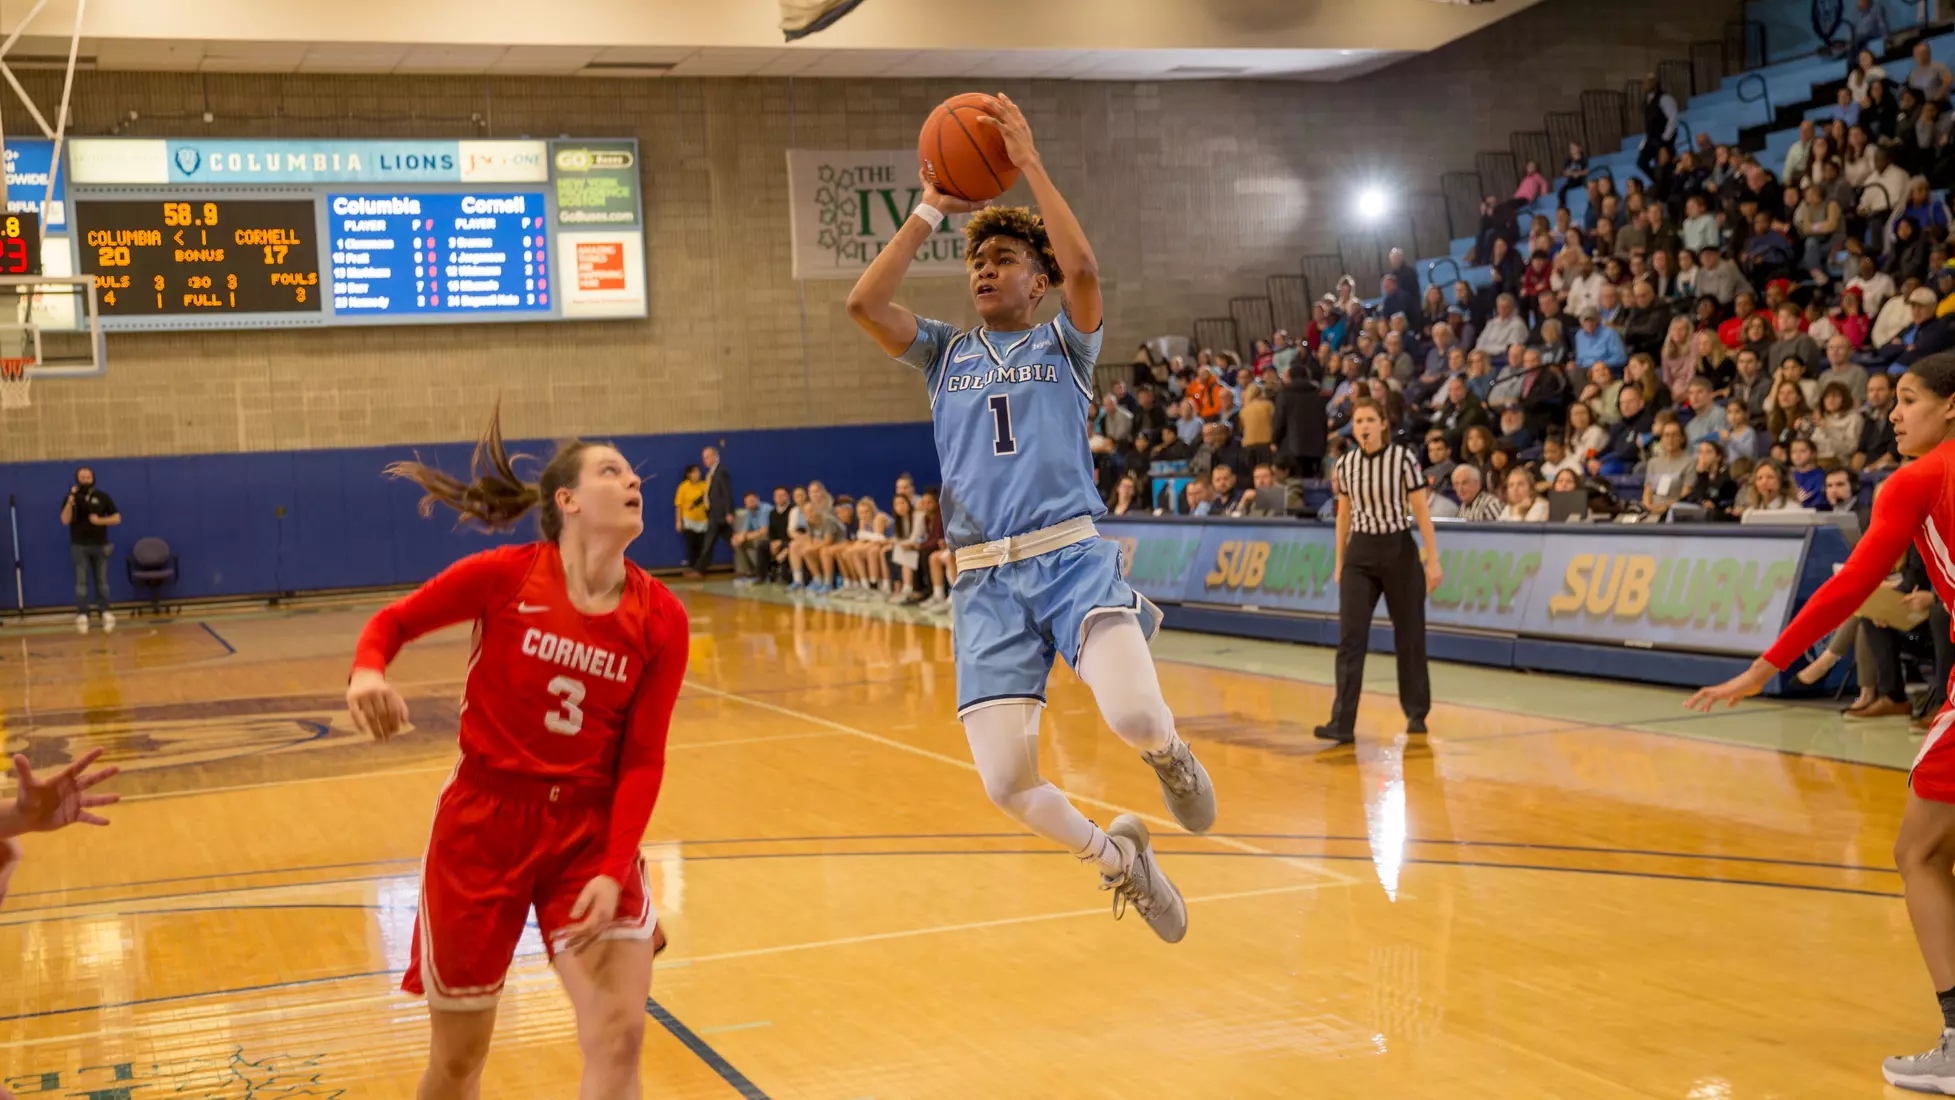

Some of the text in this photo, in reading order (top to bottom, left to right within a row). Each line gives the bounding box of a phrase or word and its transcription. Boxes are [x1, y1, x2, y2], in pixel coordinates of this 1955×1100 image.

[209, 152, 362, 172] COLUMBIA
[380, 154, 454, 170] LIONS
[557, 152, 587, 168] GO
[854, 165, 896, 183] THE
[164, 203, 218, 226] 58.9
[333, 197, 421, 215] Columbia
[461, 196, 525, 214] Cornell
[344, 220, 386, 232] PLAYER
[412, 219, 421, 231] P
[455, 218, 496, 230] PLAYER
[522, 217, 531, 229] P
[559, 210, 634, 223] GoBuses.com
[88, 230, 161, 246] COLUMBIA
[235, 229, 300, 245] CORNELL
[0, 238, 27, 273] 3
[99, 245, 288, 266] 20 BONUS 17
[860, 239, 965, 263] LGUE
[271, 273, 317, 286] FOULS
[104, 290, 117, 306] 4
[184, 294, 222, 307] FULL
[947, 364, 1058, 392] COLUMBIA
[987, 393, 1016, 456] 1
[1204, 541, 1336, 594] SUBWAY
[1549, 553, 1795, 630] SUBWAY
[521, 627, 628, 683] CORNELL
[544, 674, 586, 736] 3
[549, 785, 560, 802] C
